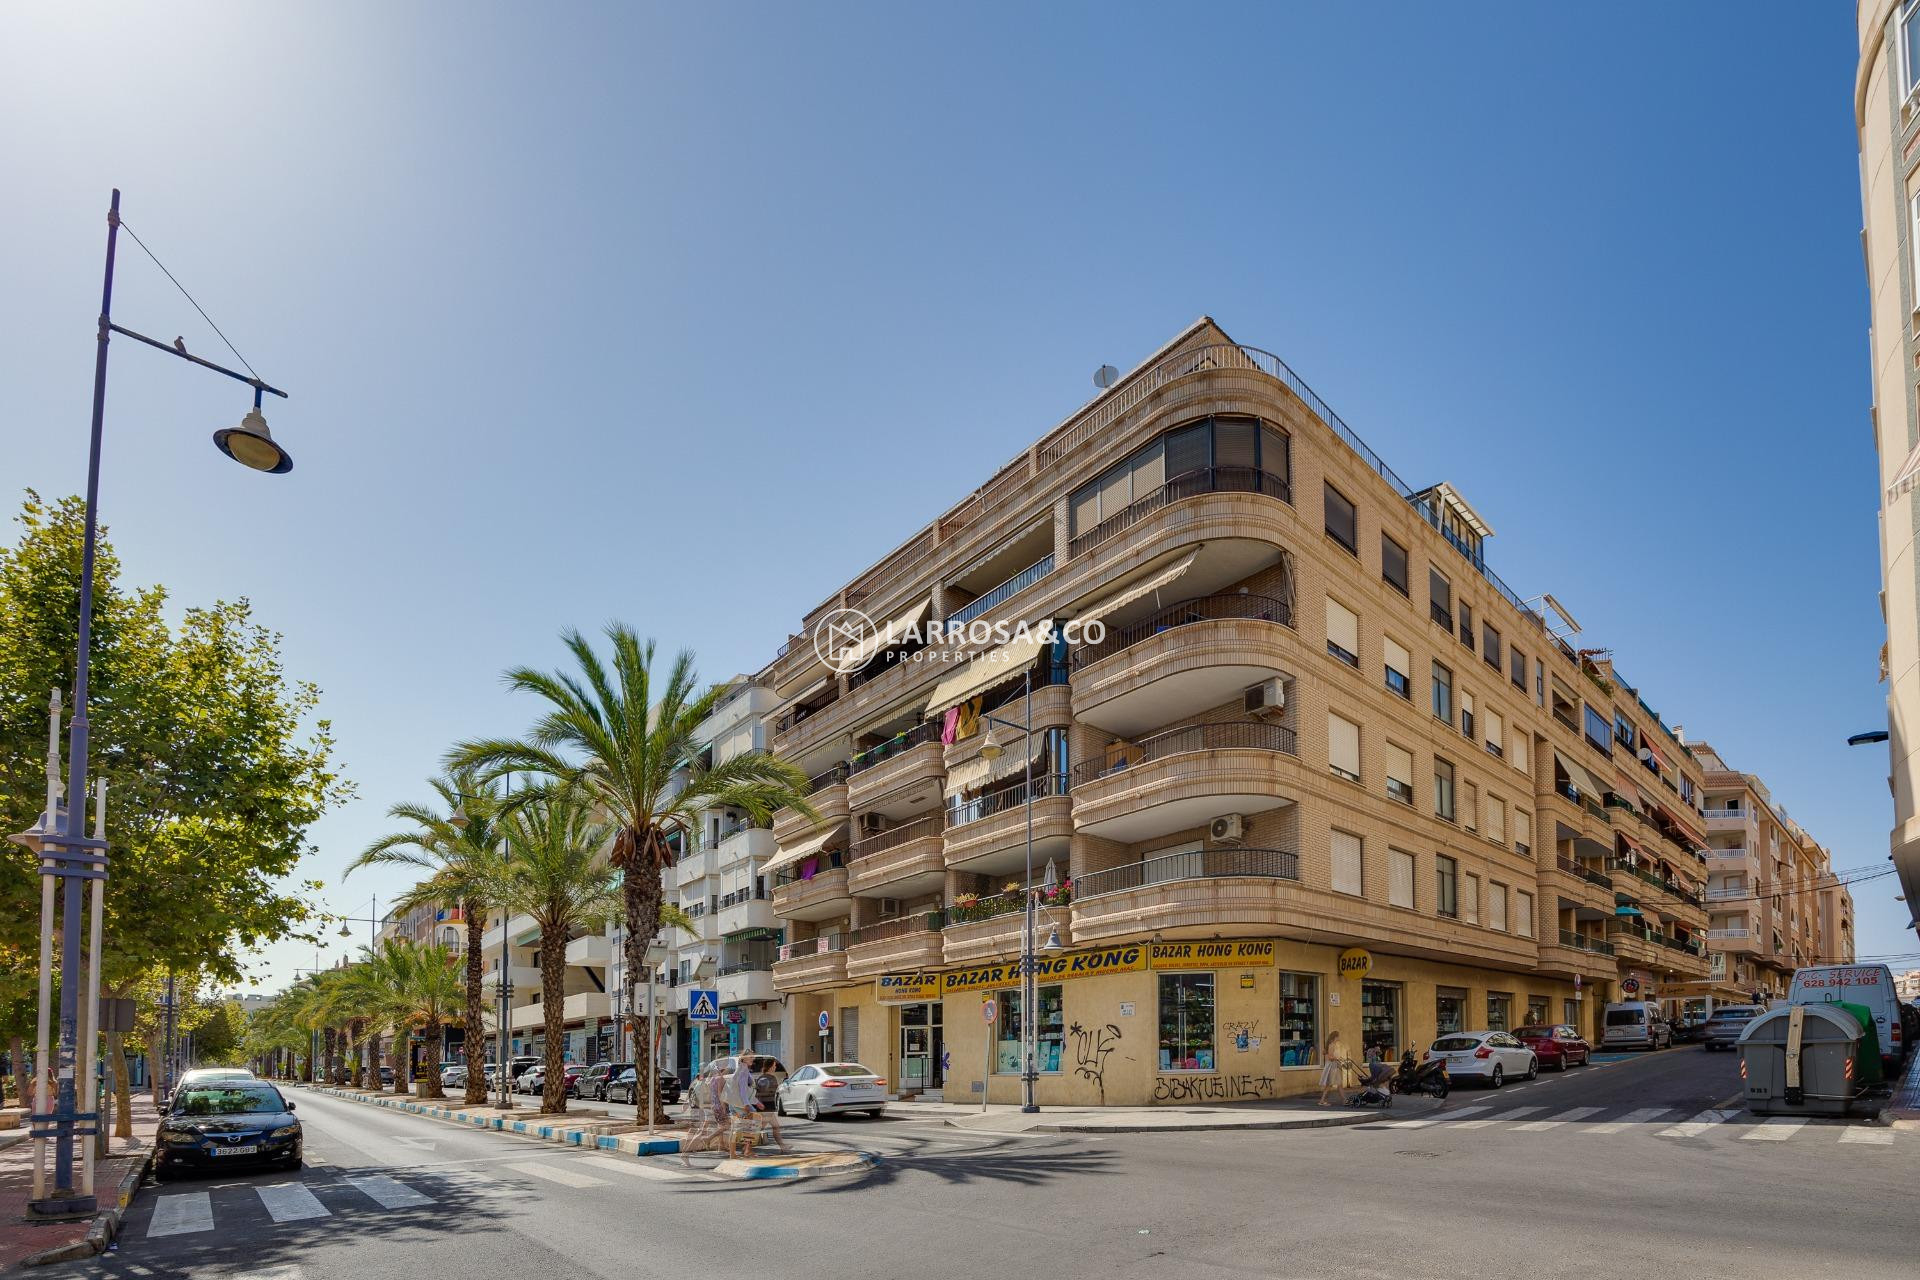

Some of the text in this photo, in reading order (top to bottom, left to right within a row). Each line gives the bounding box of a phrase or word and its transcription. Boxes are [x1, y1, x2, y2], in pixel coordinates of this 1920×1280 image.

[1152, 942, 1273, 958] BAZAR HONG KONG
[946, 968, 1004, 988] BAZAR
[1008, 958, 1068, 980] HNG
[1071, 948, 1140, 972] KONG
[1341, 956, 1368, 971] BAZAR
[1830, 968, 1880, 979] SERVICE
[881, 975, 936, 987] BAZAR
[1804, 976, 1878, 988] 628 942 105
